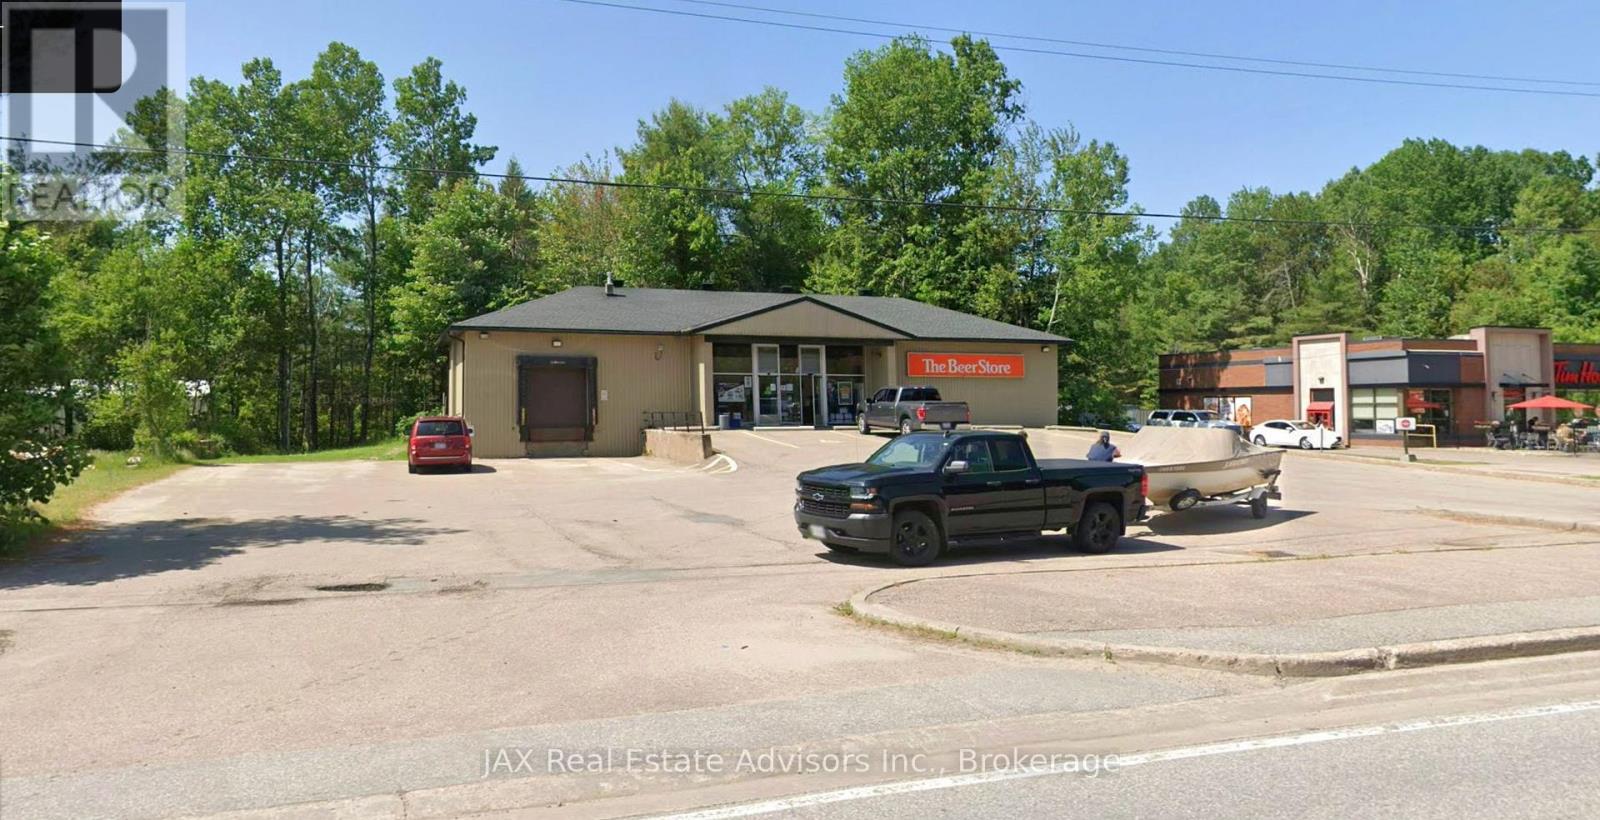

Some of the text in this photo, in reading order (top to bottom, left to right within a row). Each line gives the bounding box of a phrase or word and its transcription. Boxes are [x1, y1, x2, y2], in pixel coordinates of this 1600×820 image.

[922, 358, 1011, 375] The Beer Store
[1553, 361, 1579, 384] Tim
